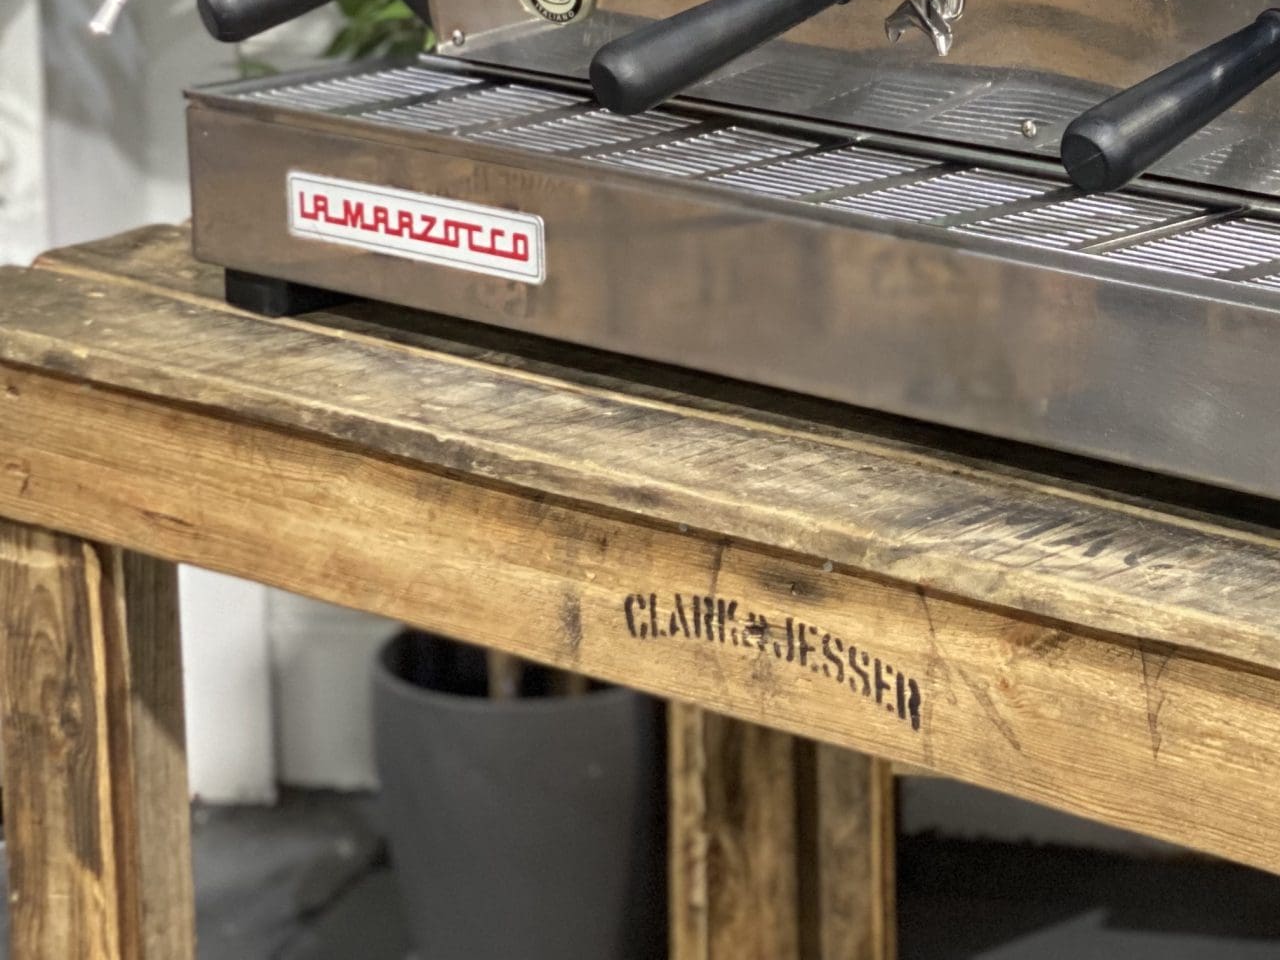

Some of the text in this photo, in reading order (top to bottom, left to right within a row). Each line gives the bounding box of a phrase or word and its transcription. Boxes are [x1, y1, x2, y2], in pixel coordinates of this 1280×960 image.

[535, 2, 575, 21] ITALIANO
[299, 191, 529, 262] LA MARZOCCO
[772, 616, 922, 732] JESSER
